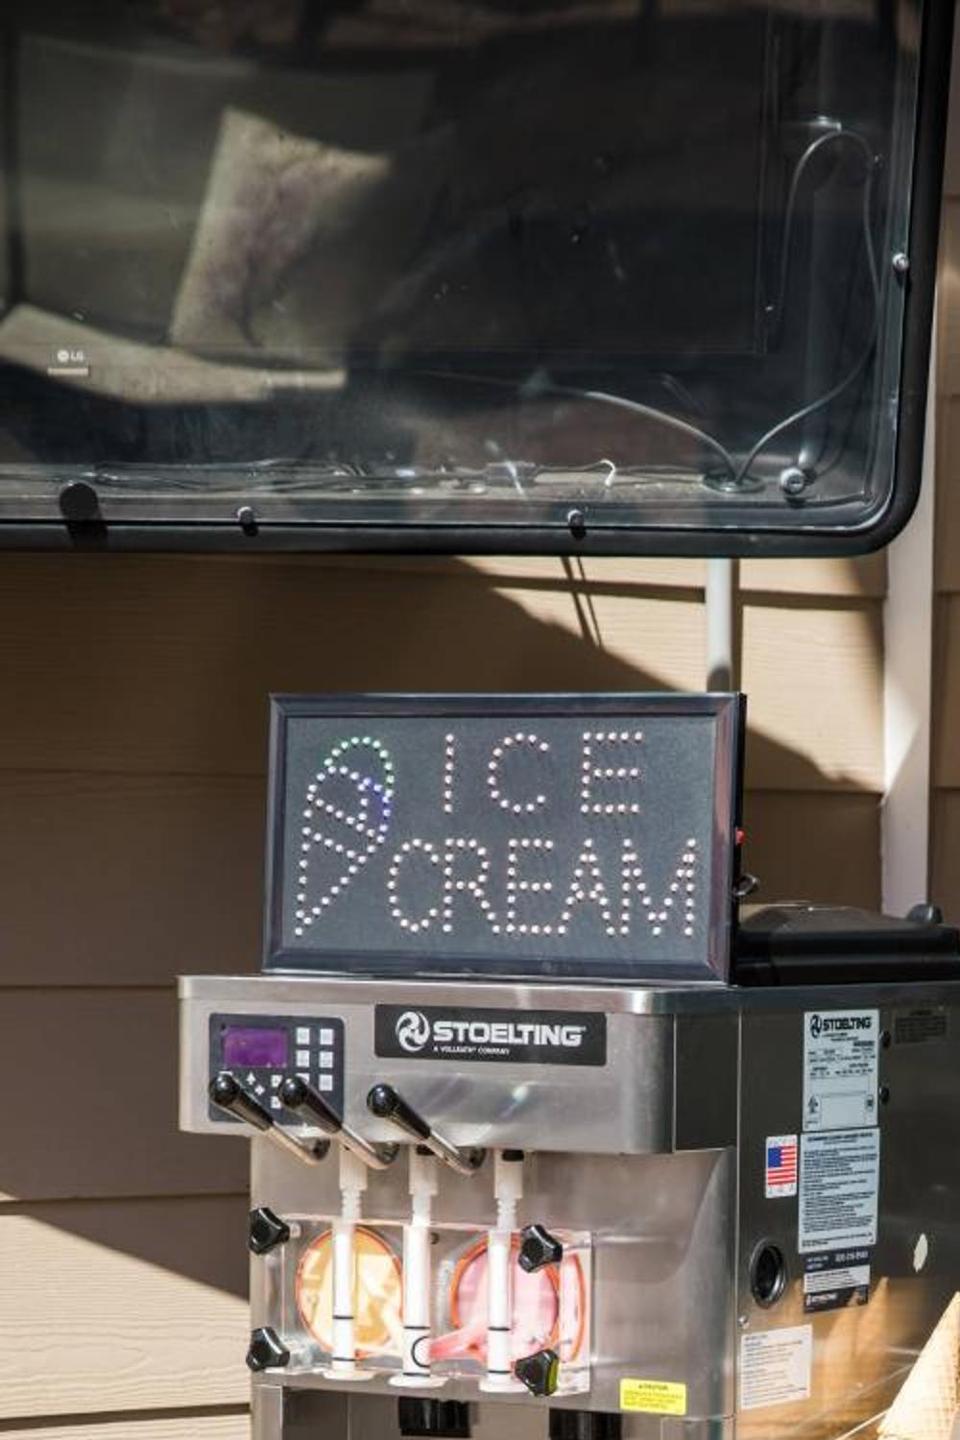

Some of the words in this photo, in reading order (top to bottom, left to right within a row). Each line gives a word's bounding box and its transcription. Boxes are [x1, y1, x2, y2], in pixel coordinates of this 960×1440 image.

[443, 731, 644, 814] ICE
[387, 836, 697, 937] CREAM
[433, 1020, 583, 1047] STOELTING
[823, 1016, 872, 1031] STOELTING
